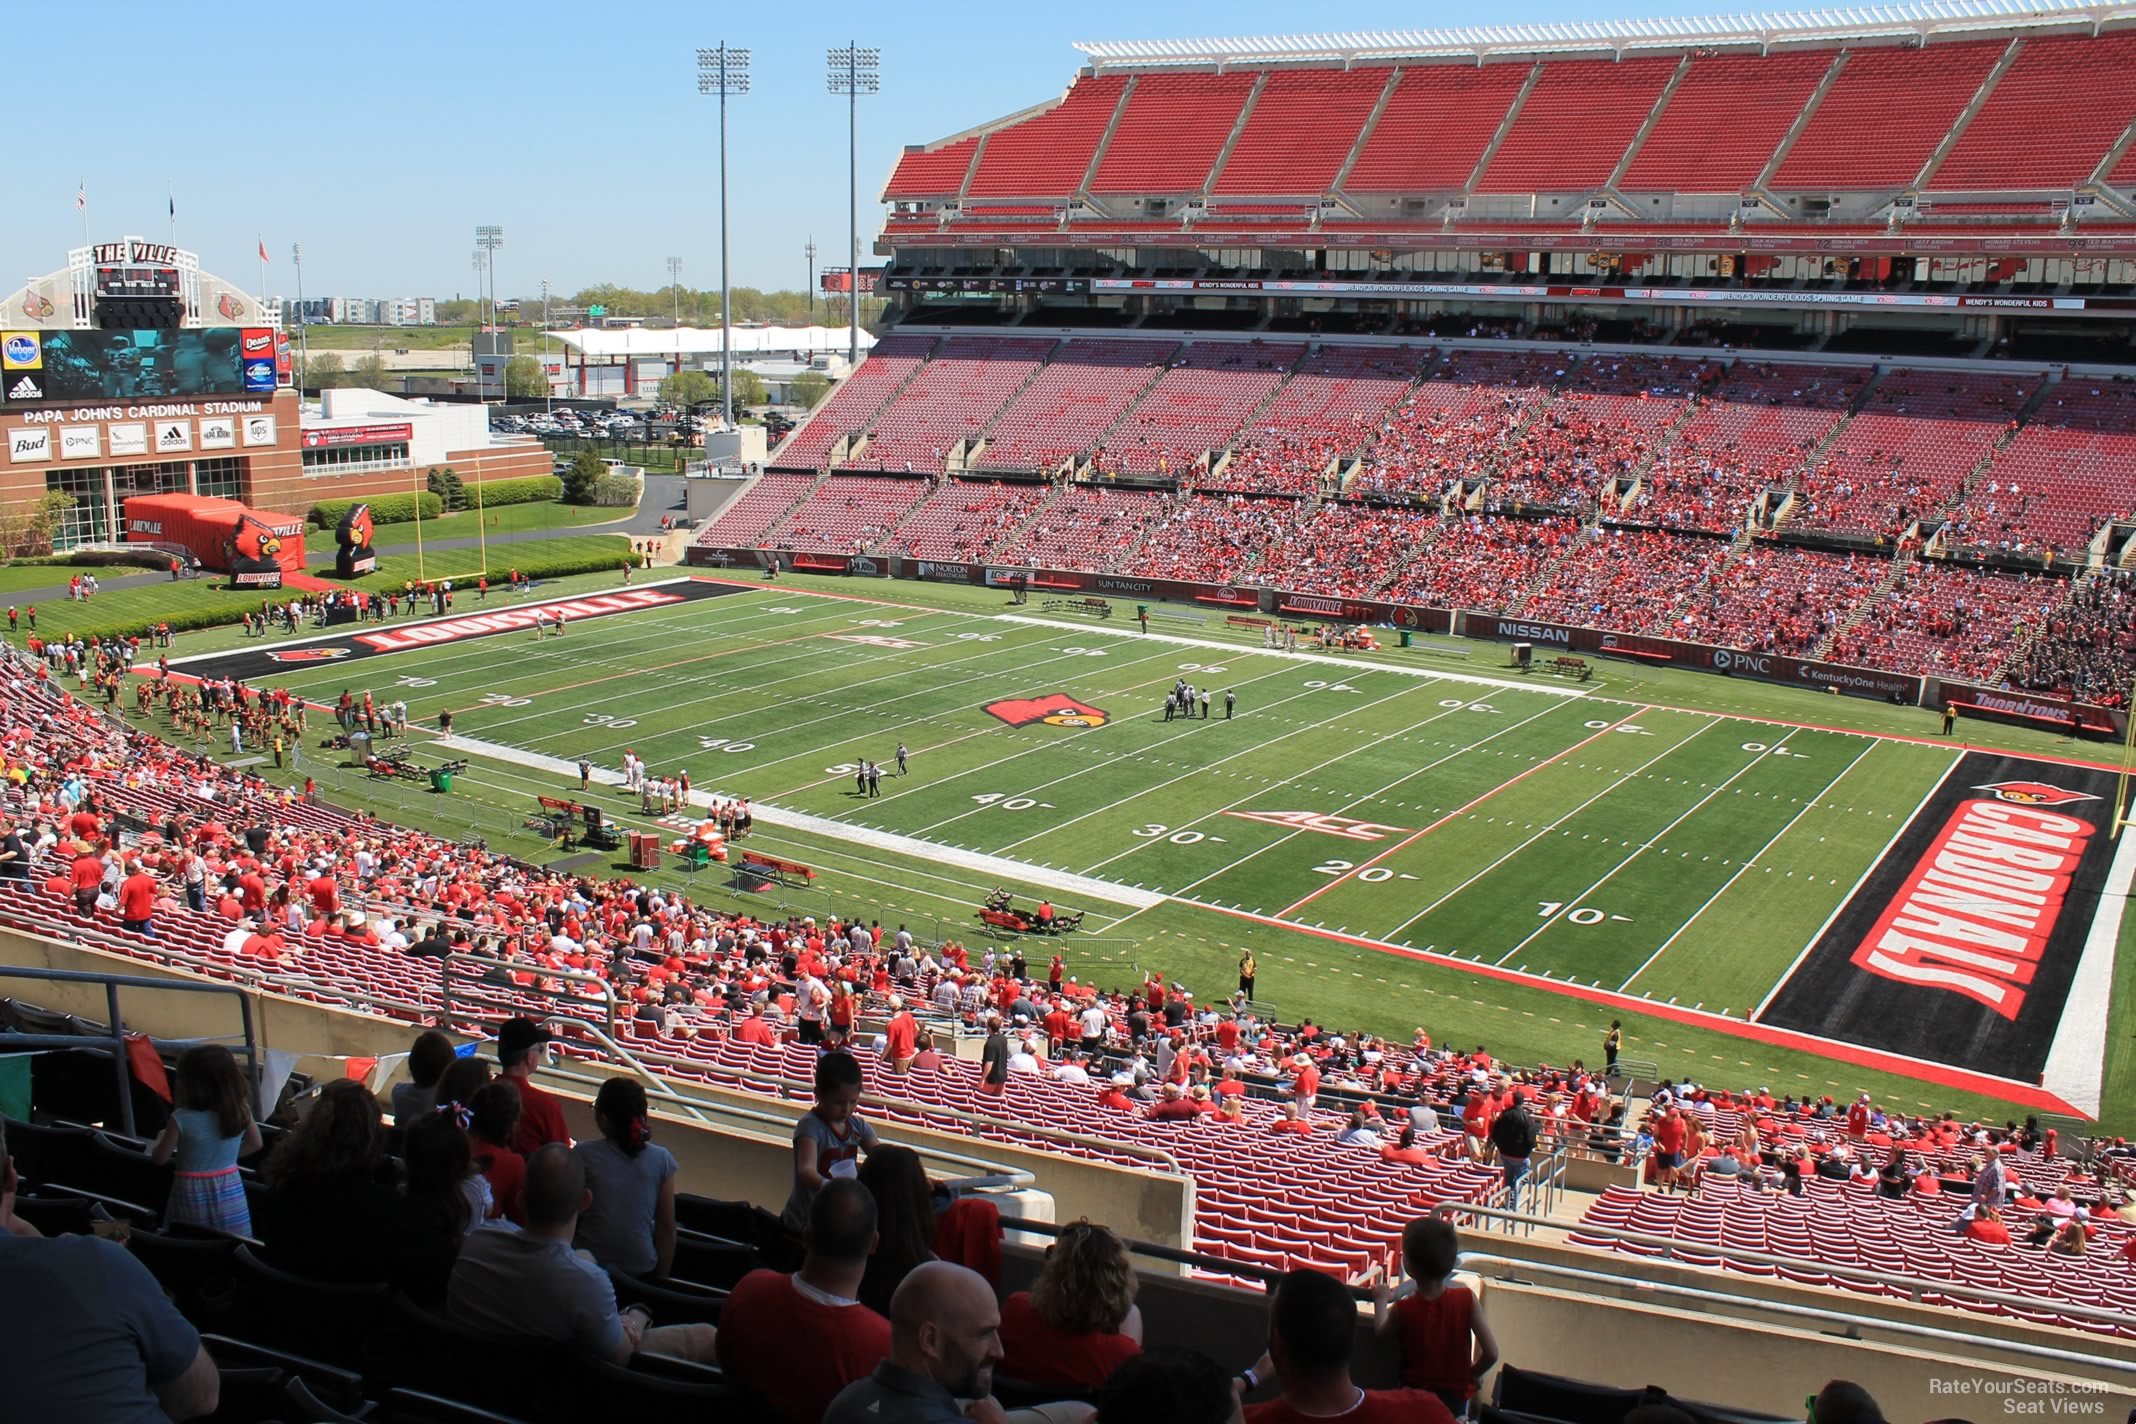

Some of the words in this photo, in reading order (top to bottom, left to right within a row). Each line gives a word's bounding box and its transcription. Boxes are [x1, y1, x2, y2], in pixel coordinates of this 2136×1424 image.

[94, 243, 125, 264] THE
[132, 243, 177, 264] VILLE
[2067, 240, 2085, 250] 99
[1721, 292, 1751, 300] WENDY'S
[1753, 293, 1794, 301] WONDERFUL
[1812, 295, 1839, 303] SPRING
[1965, 298, 1992, 306] WENDY'S
[8, 339, 36, 360] Kroger
[9, 388, 43, 399] adidas
[24, 410, 65, 423] PAPA
[71, 406, 123, 421] JOHN'S
[128, 403, 199, 418] CARDINAL
[204, 401, 262, 414] STADIUM
[75, 437, 94, 445] PNC
[251, 426, 267, 438] ups
[14, 436, 46, 453] Bud
[160, 438, 187, 446] adidas
[935, 571, 968, 579] HEALTHCARE
[936, 563, 968, 573] NORTON
[236, 572, 281, 584] LOUISVILLE
[1098, 580, 1114, 588] SUN
[1115, 581, 1133, 590] TAN
[1133, 583, 1152, 591] CITY
[1288, 595, 1343, 613] LOUISVILLE
[362, 590, 683, 650] LOUISVILLE
[1499, 622, 1569, 642] NISSAN
[1734, 654, 1770, 673] PNC
[1812, 669, 1875, 690] KentuckyOne
[1876, 680, 1905, 692] Health
[1975, 692, 2068, 720] THORNTONS
[970, 792, 1037, 810] 40
[1132, 824, 1205, 844] 30
[1222, 810, 1415, 841] ACC
[1311, 859, 1394, 882] 20
[1538, 902, 1606, 925] 10
[1860, 801, 2088, 1012] CARDINALS
